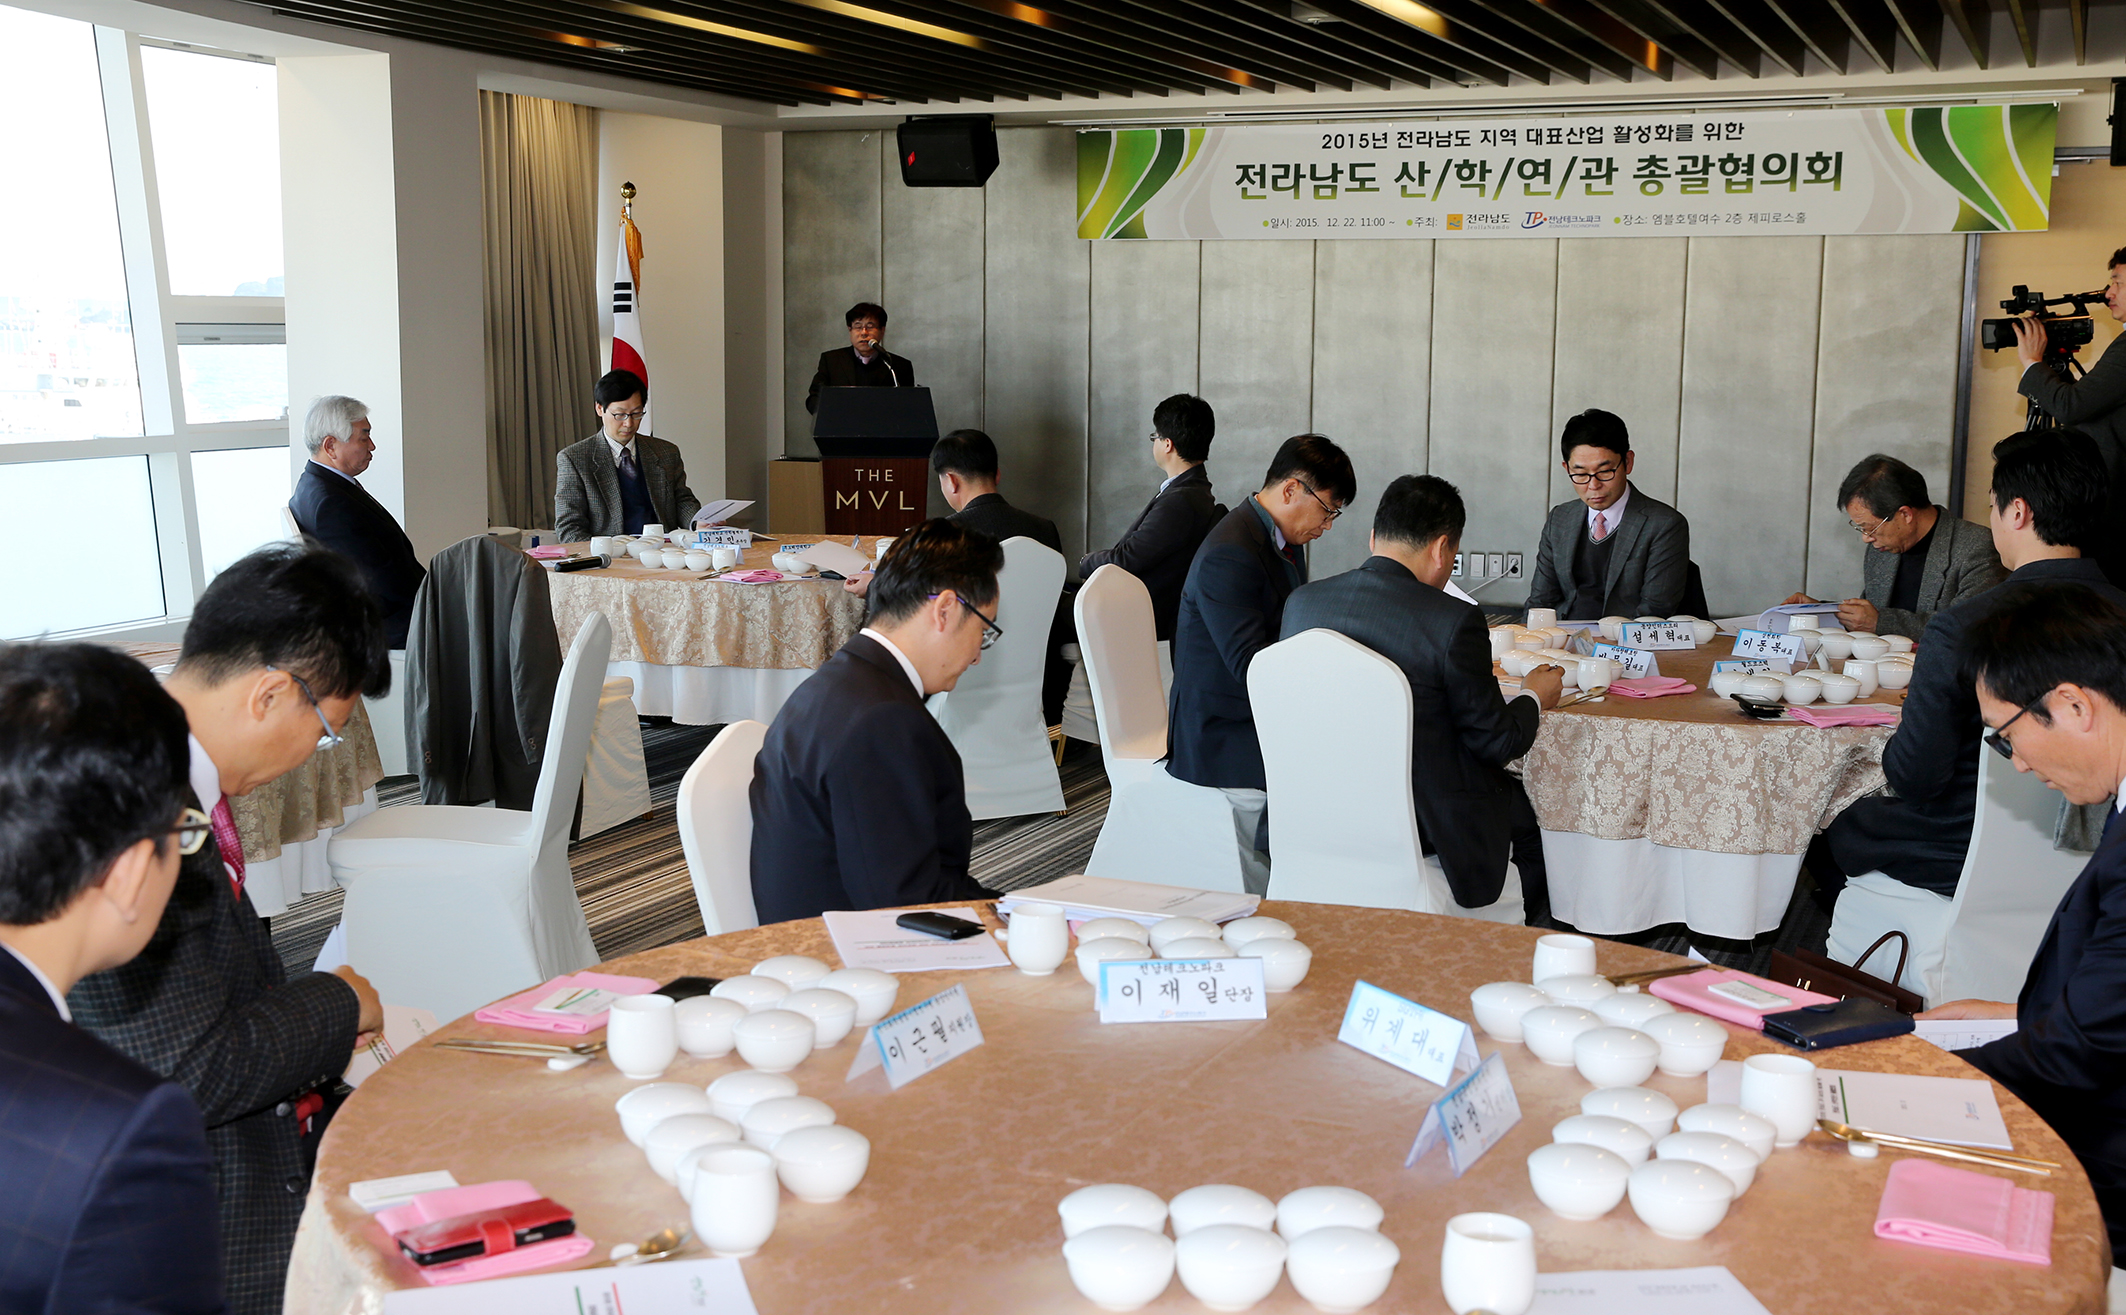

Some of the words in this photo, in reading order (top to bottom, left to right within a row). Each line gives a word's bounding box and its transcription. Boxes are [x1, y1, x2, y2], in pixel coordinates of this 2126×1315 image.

[1321, 131, 1388, 149] 2015년
[1396, 130, 1471, 149] 전라남도
[1480, 128, 1517, 147] 지역
[1526, 126, 1604, 146] 대표산업
[1613, 123, 1694, 144] 활성화를
[1703, 121, 1745, 141] 위한
[1234, 160, 1381, 200] 전라남도
[1393, 155, 1619, 201] 산/학/연/관
[1632, 151, 1844, 196] 총괄협의회
[1270, 217, 1293, 229] 일시:
[1295, 217, 1320, 228] 2015.
[1327, 217, 1340, 227] 12.
[1343, 217, 1357, 227] 22.
[1360, 217, 1386, 227] 11:00
[1414, 216, 1438, 228] 주최:
[1466, 213, 1511, 224] 전라남도
[1548, 215, 1602, 224] 전남테크노파크
[1622, 214, 1648, 226] 장소:
[1652, 213, 1721, 226] 엠블호텔여수
[1724, 213, 1743, 225] 2층
[1747, 211, 1807, 225] 제피로스홀
[854, 468, 894, 482] THE
[836, 490, 915, 511] MVL
[1631, 629, 1676, 644] 설세혁
[1676, 634, 1691, 642] 대표
[1138, 961, 1226, 976] 전남테크노파크
[1121, 976, 1218, 1007] 이재일
[1224, 985, 1254, 1003] 단장
